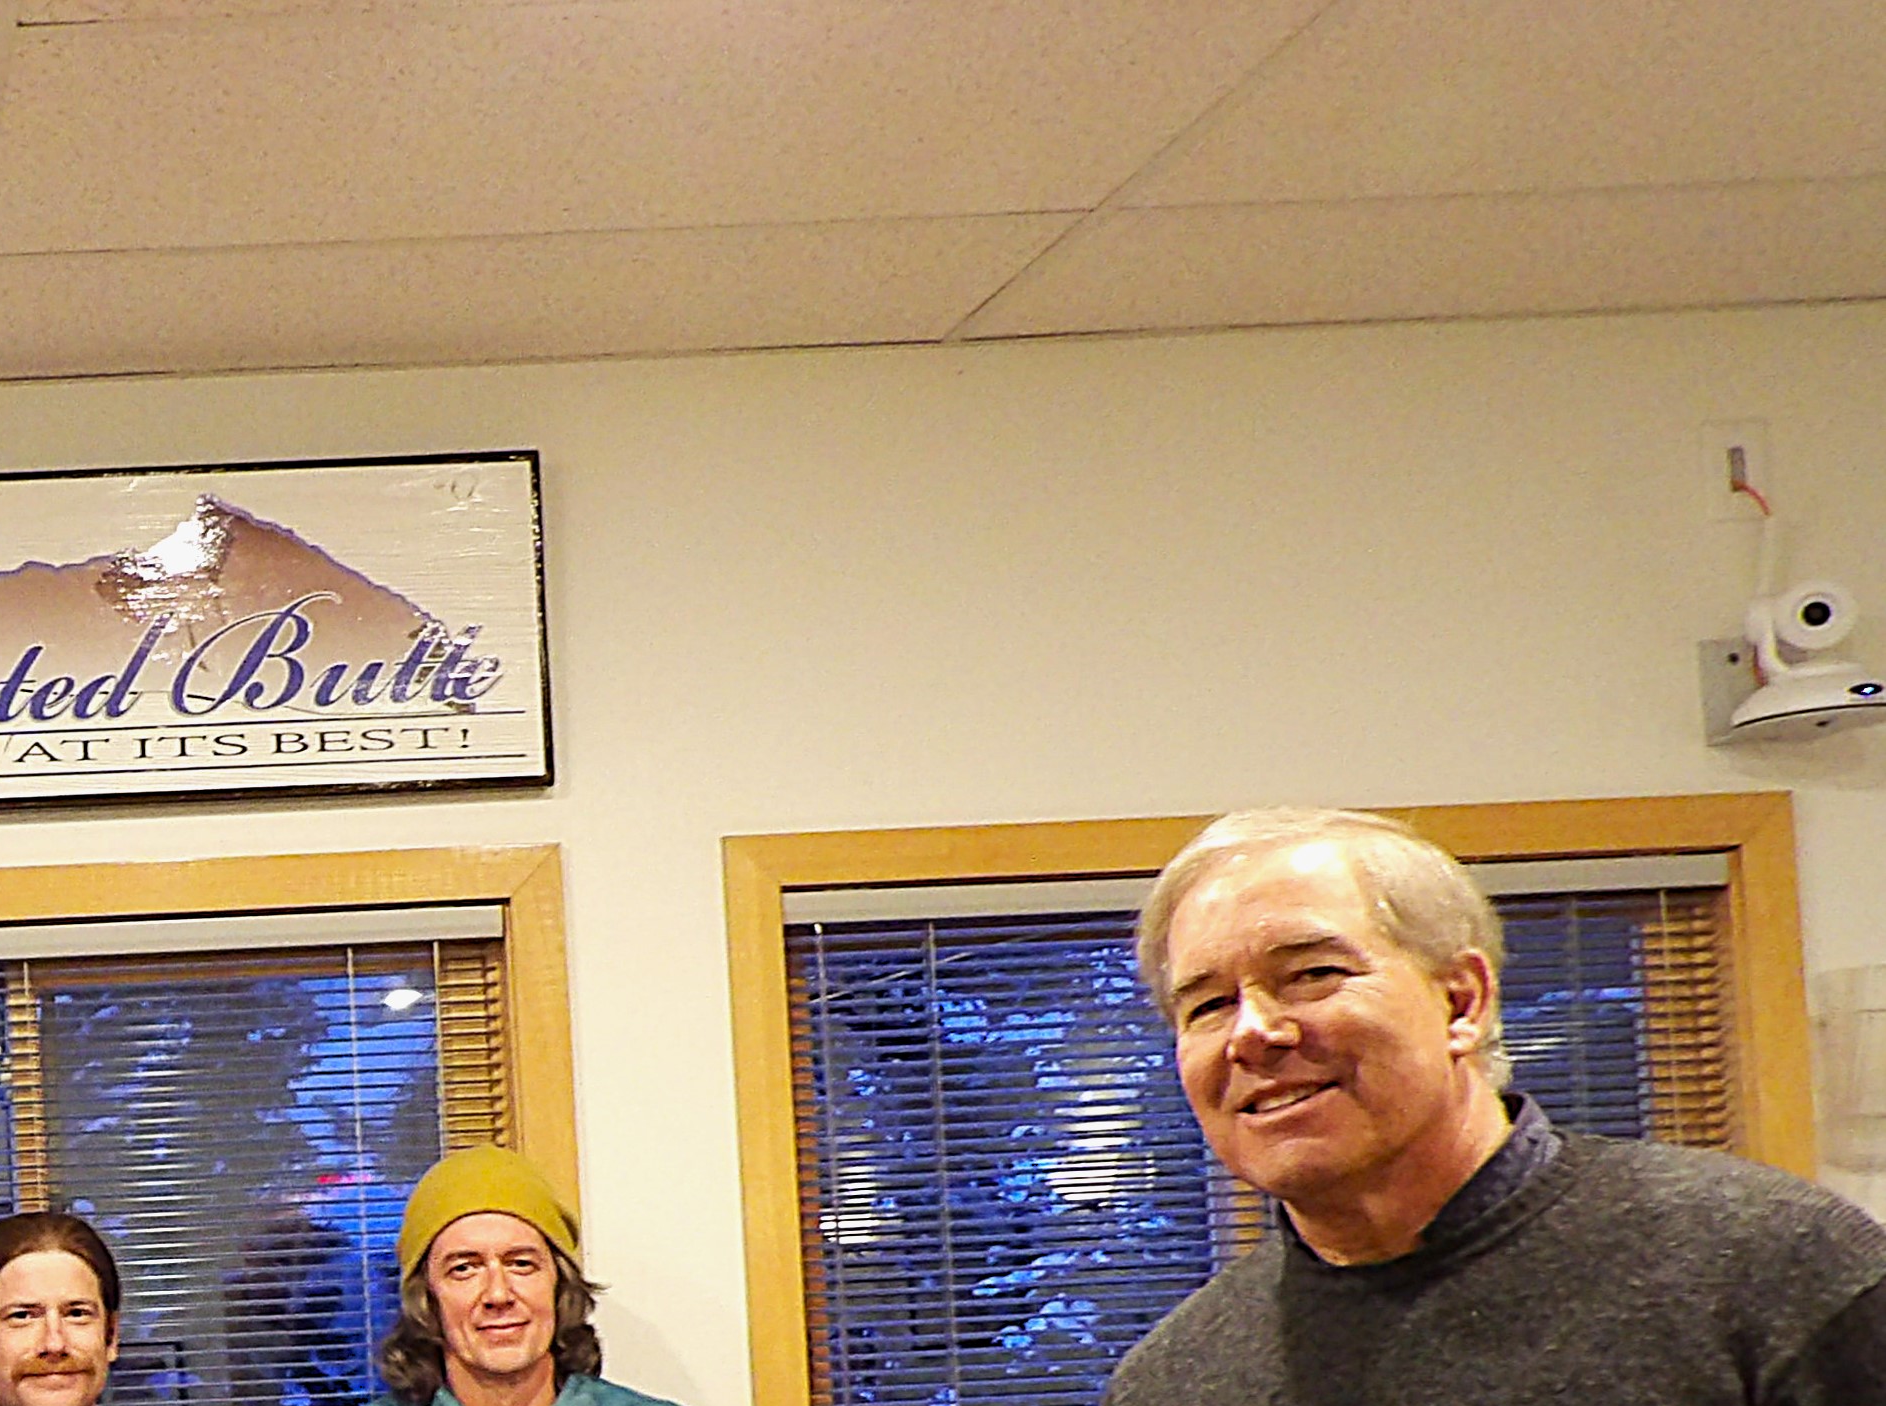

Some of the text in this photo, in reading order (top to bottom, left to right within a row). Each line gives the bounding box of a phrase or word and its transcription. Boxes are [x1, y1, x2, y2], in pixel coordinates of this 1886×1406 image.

[170, 592, 504, 716] Butte
[13, 738, 110, 763] AT
[133, 732, 248, 759] ITS
[271, 727, 470, 755] BEST!
